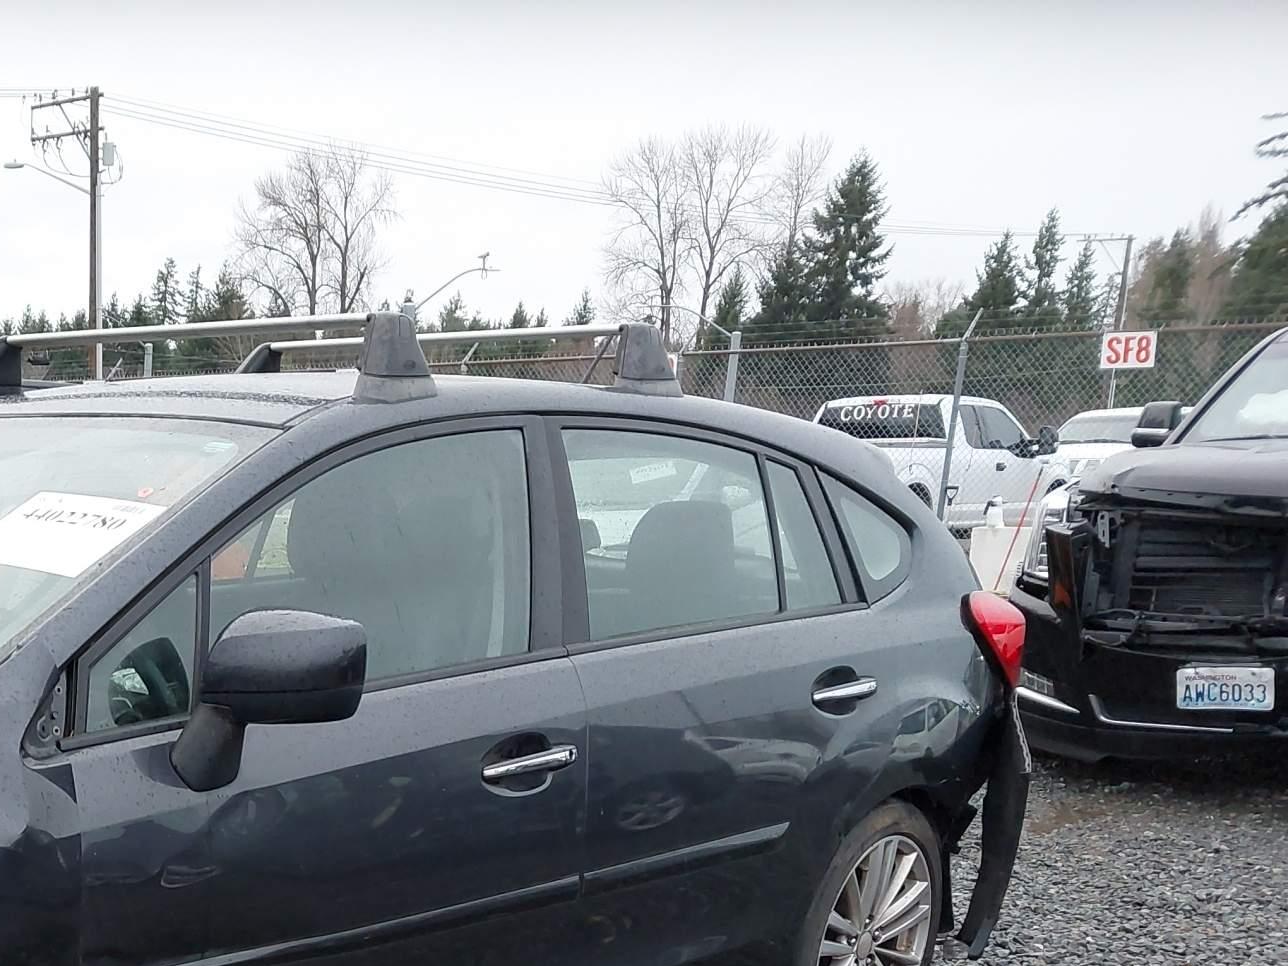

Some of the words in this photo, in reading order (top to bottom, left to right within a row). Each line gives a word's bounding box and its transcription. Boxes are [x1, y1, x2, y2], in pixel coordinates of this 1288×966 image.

[1106, 335, 1152, 364] SF8
[840, 404, 915, 421] COYOTE
[23, 509, 127, 530] 44022780
[1183, 682, 1267, 703] AWC6033
